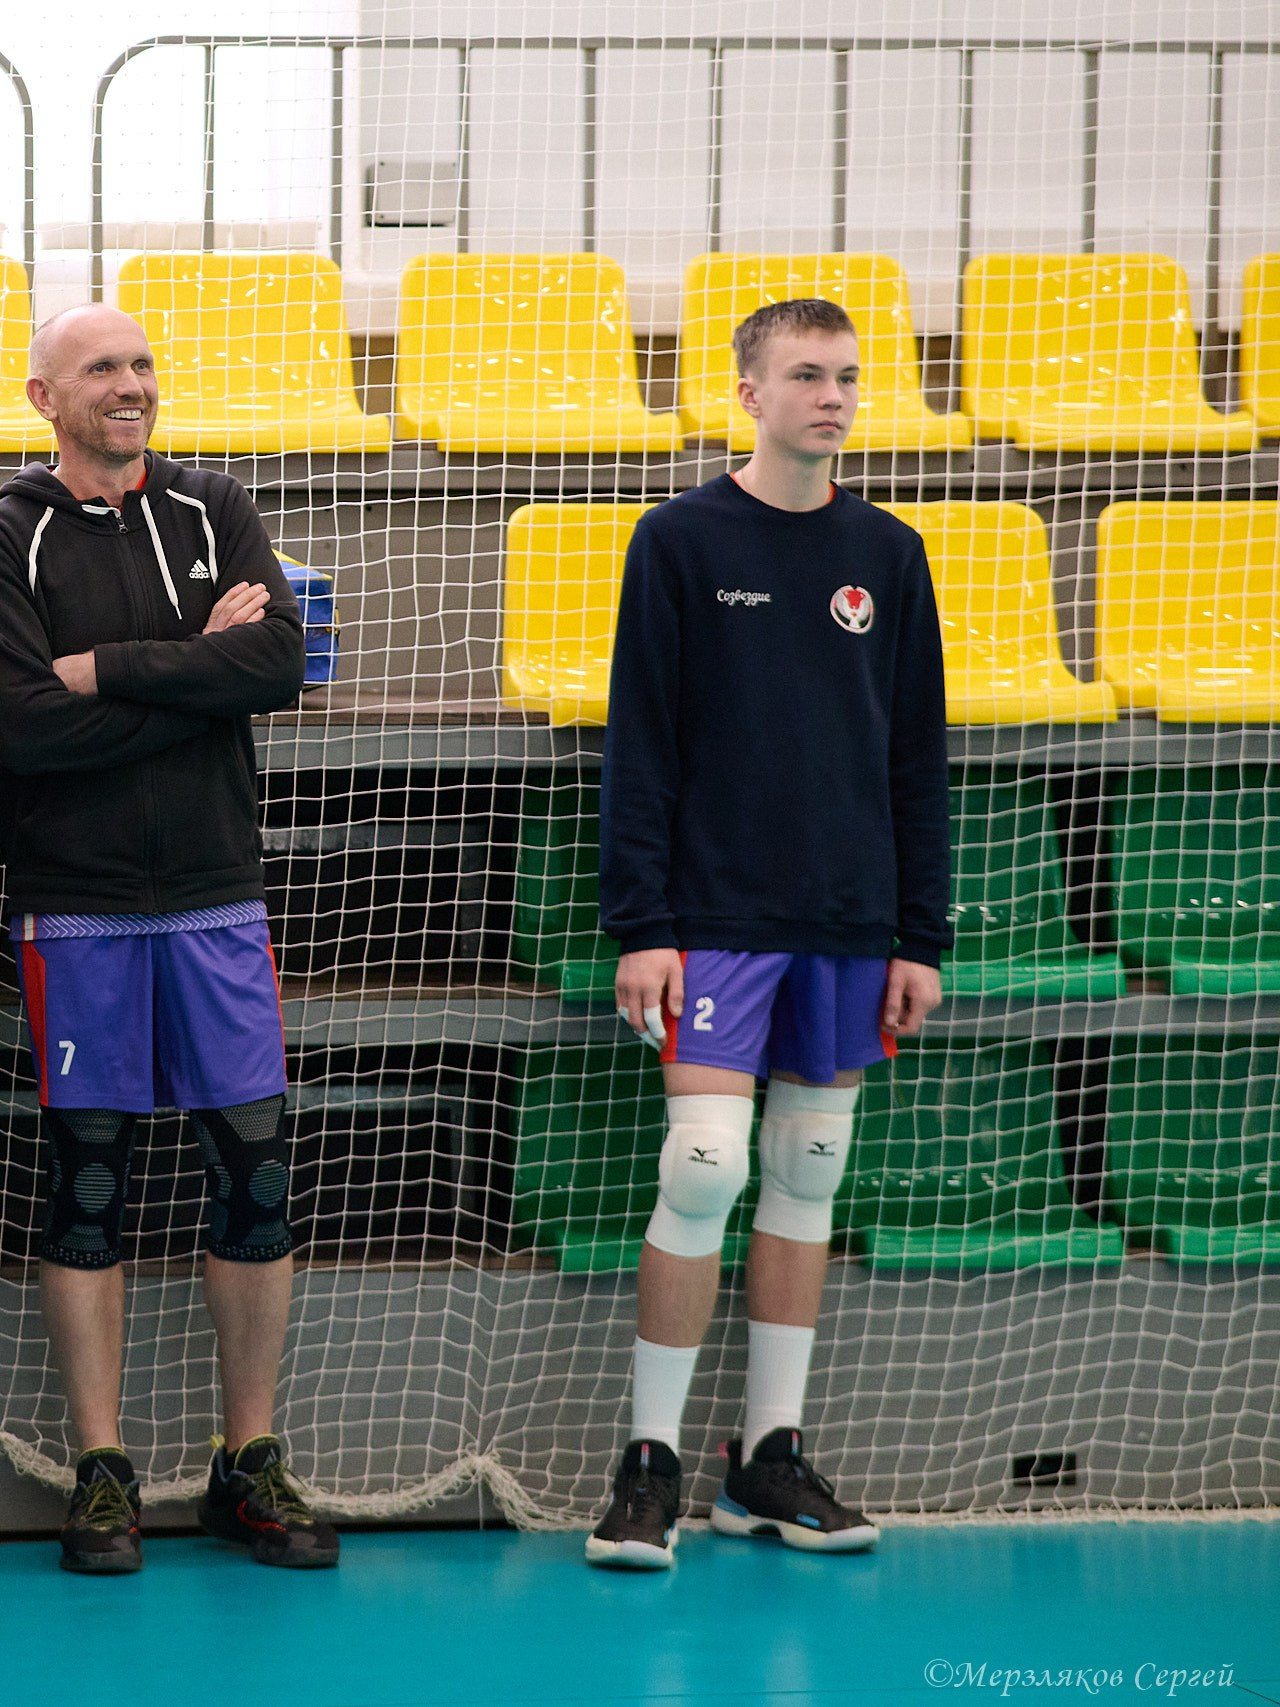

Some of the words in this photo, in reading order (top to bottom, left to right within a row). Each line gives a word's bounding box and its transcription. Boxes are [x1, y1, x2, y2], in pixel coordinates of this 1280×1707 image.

[717, 589, 771, 606] Созвездие
[693, 996, 714, 1031] 2
[58, 1040, 76, 1075] 7
